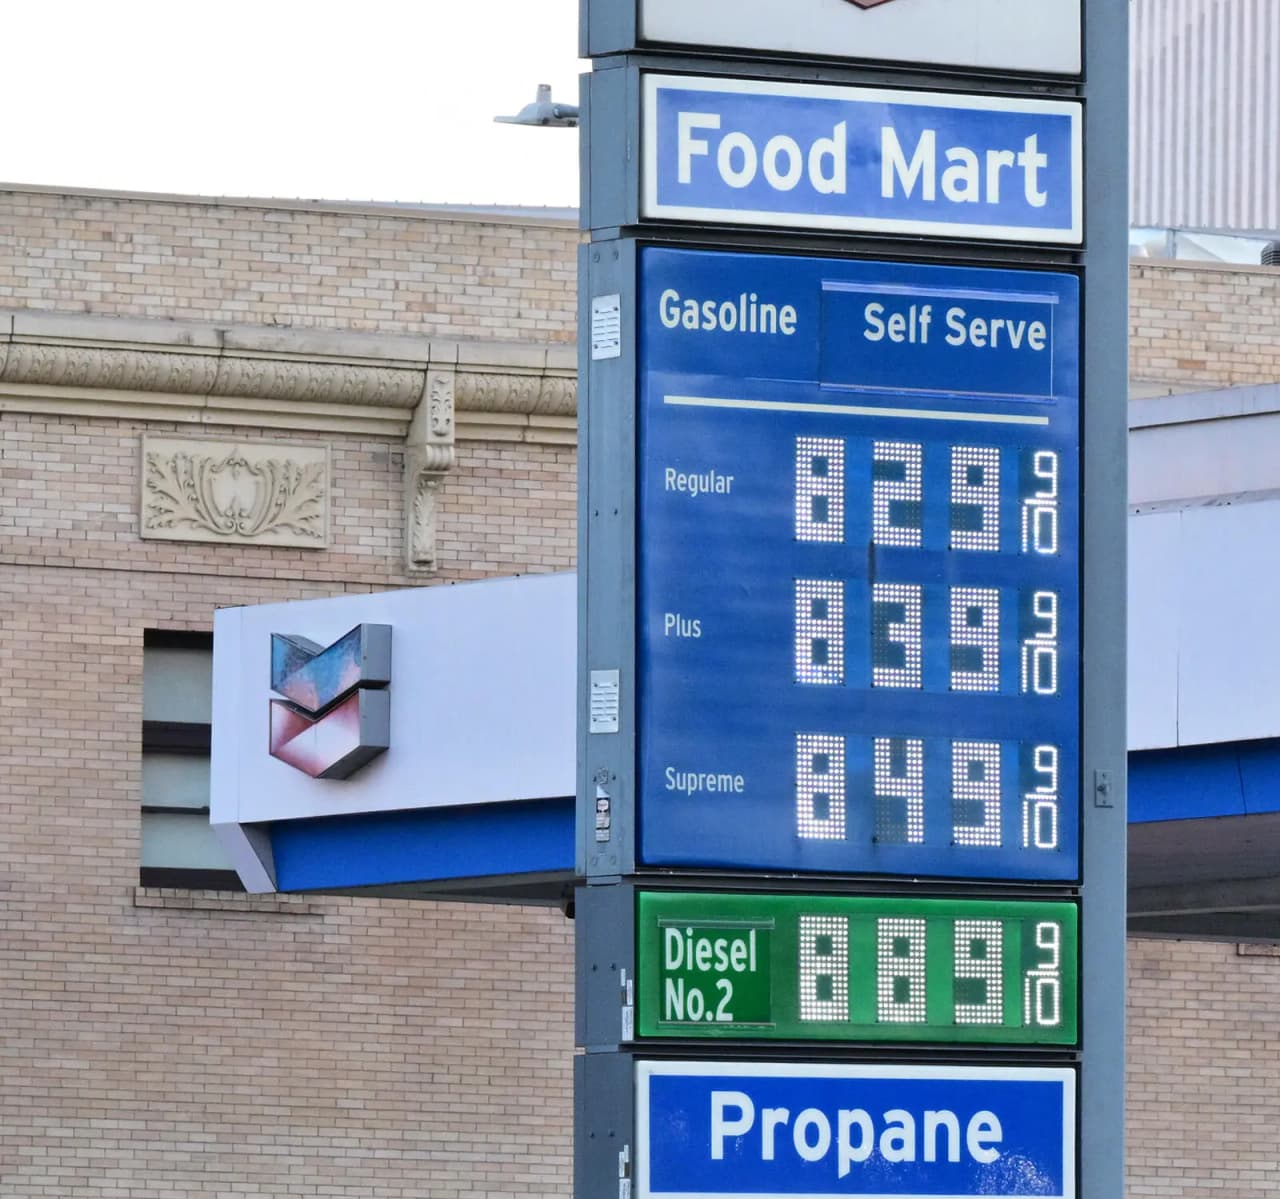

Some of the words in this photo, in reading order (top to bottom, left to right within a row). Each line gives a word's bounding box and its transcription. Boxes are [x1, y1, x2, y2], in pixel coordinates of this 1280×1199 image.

[677, 111, 847, 195] Food
[880, 126, 1048, 207] Mart
[659, 289, 797, 335] Gasoline
[863, 302, 932, 345] Self
[944, 307, 1047, 351] Serve
[665, 468, 734, 496] Regular
[664, 614, 701, 638] Plus
[665, 767, 745, 794] Supreme
[665, 927, 757, 973] Diesel
[665, 978, 734, 1022] No.2
[710, 1090, 1003, 1179] Propane
